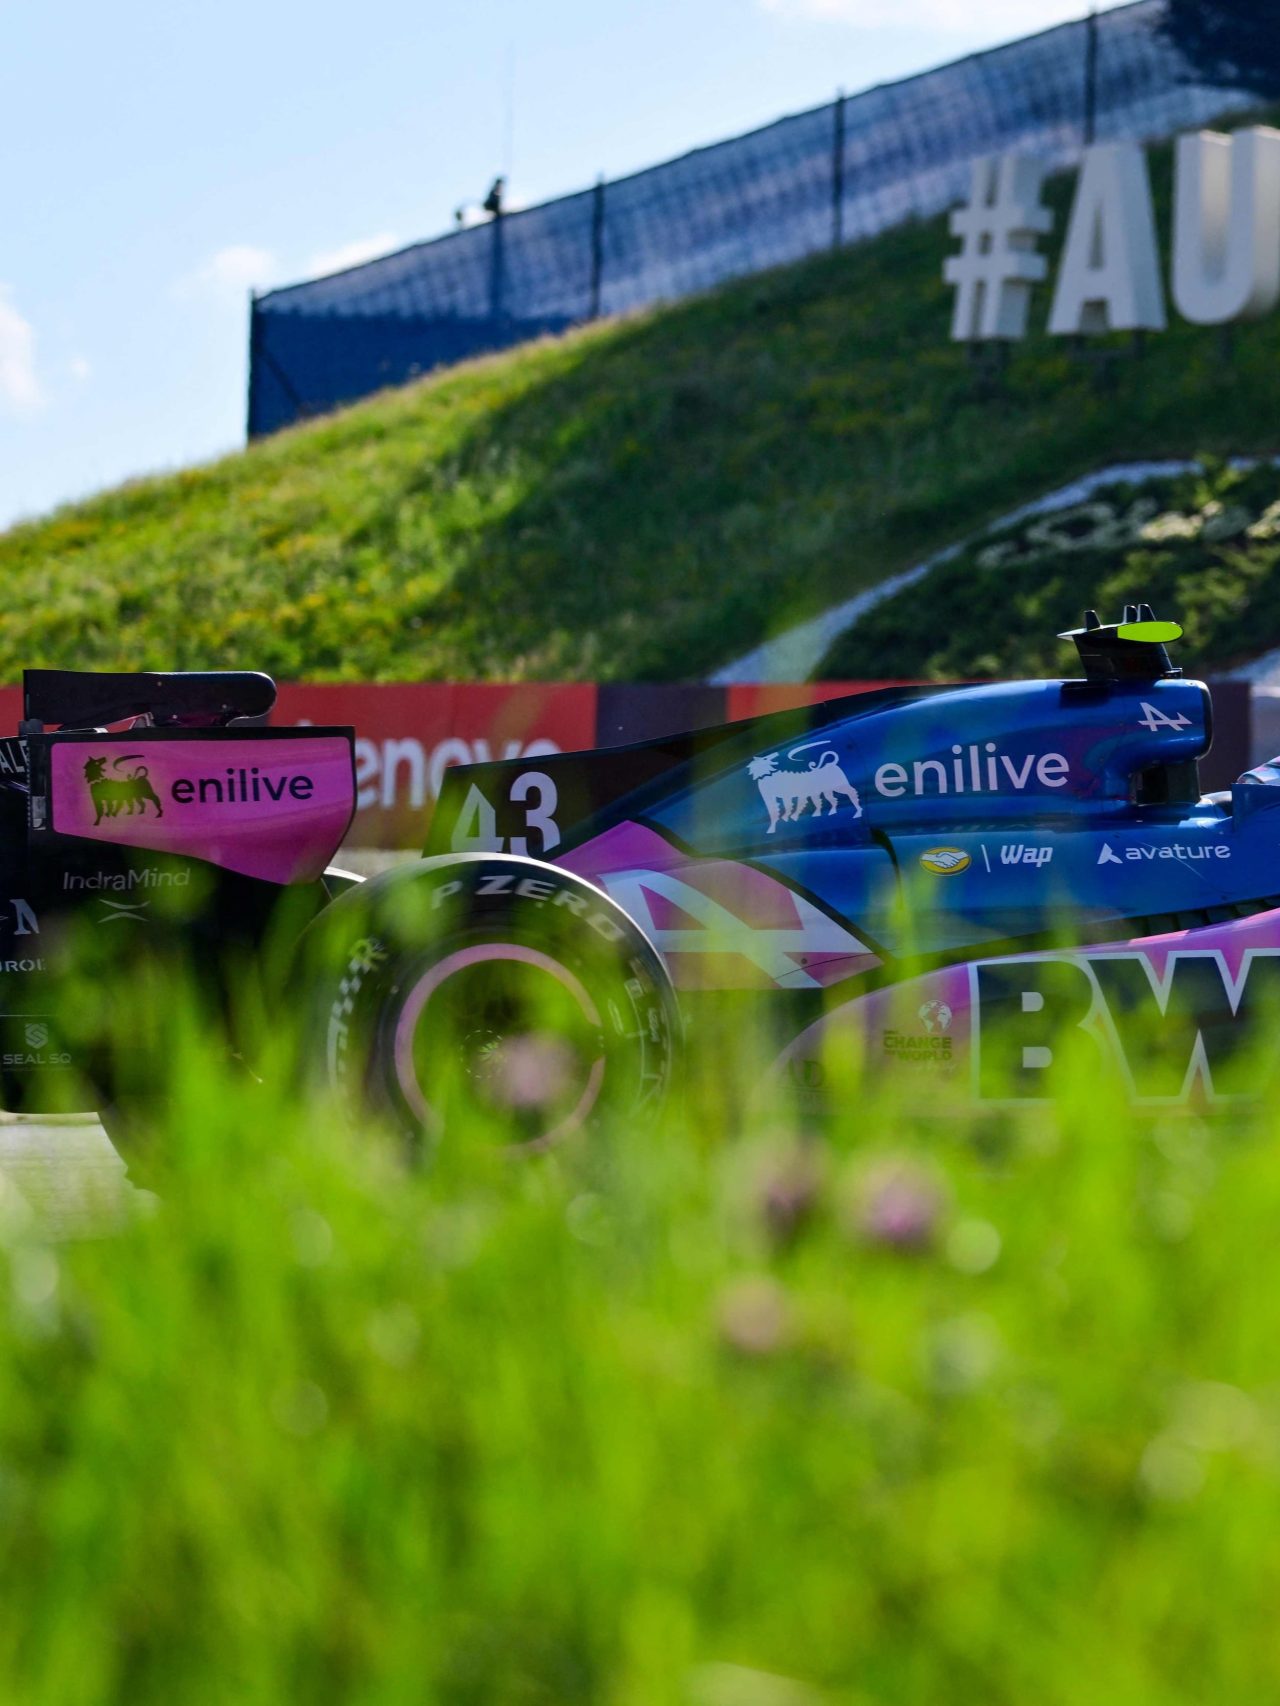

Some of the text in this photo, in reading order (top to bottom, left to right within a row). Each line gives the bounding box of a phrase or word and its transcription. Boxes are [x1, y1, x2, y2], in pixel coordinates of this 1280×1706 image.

[171, 767, 314, 804] enilive
[874, 742, 1070, 797] enilive
[451, 771, 560, 858] 43
[1000, 844, 1053, 867] Wap
[1125, 844, 1231, 860] avature
[63, 868, 190, 891] IndraMind
[475, 875, 626, 942] ZERO
